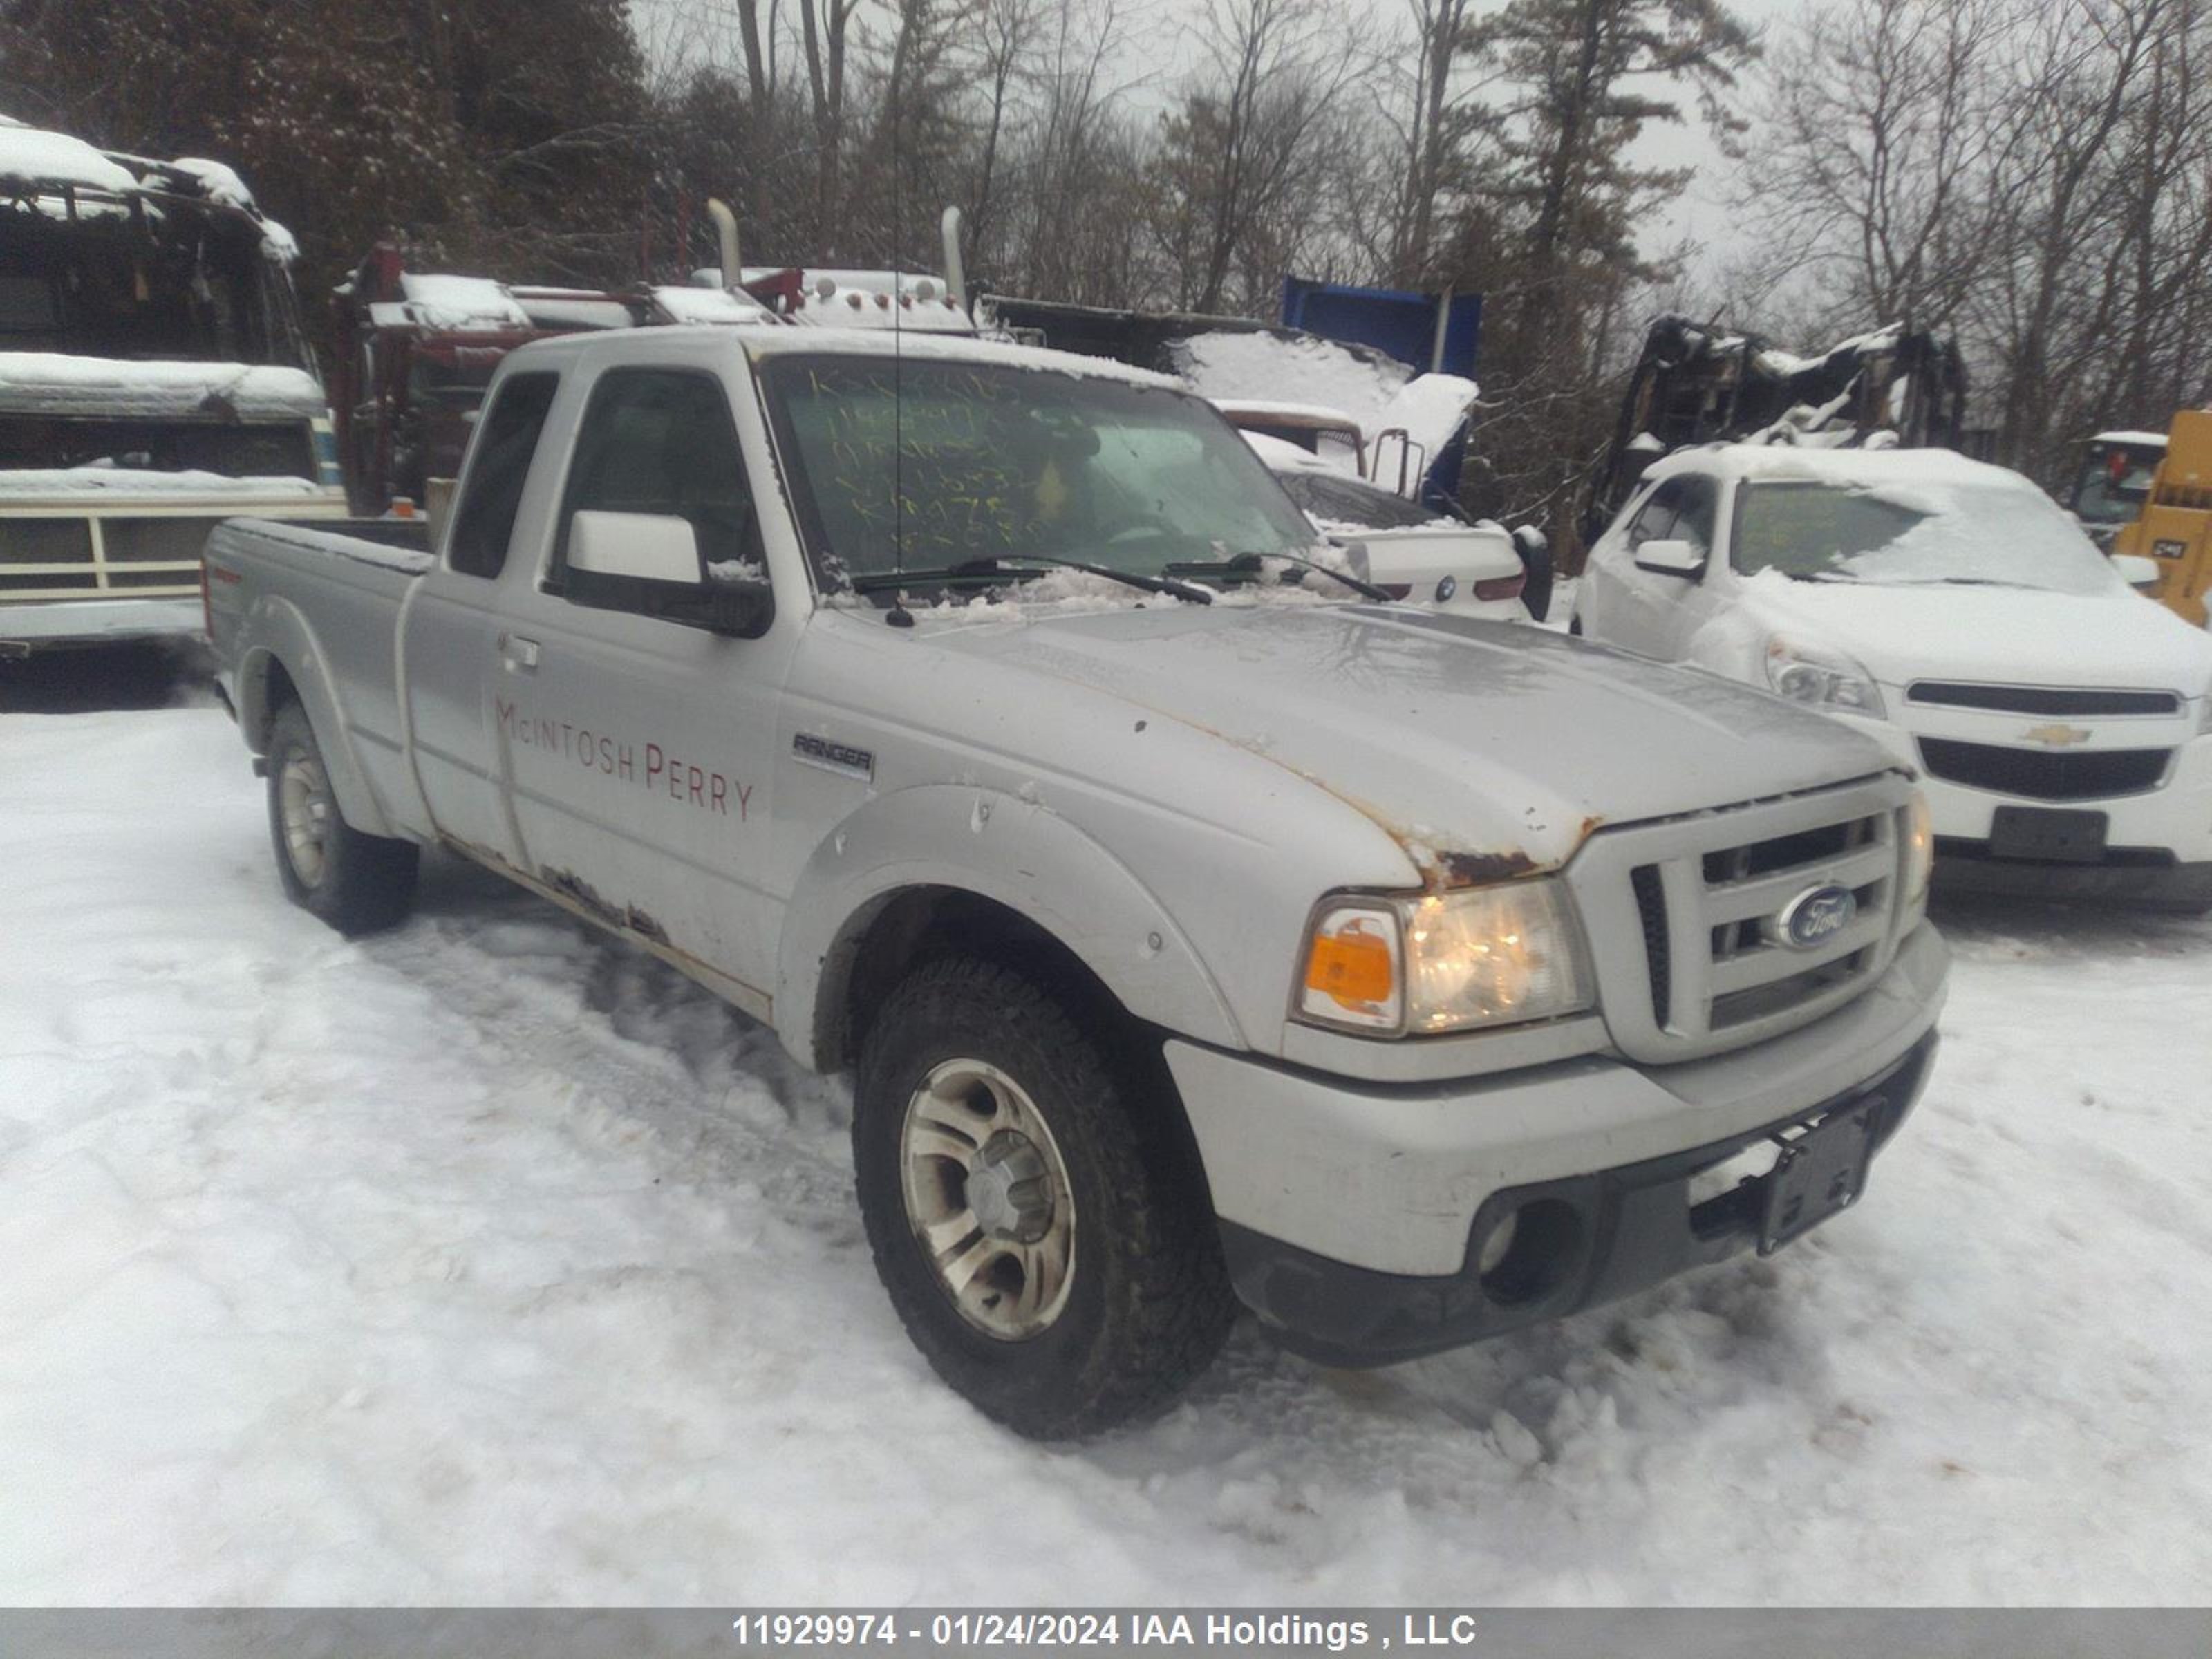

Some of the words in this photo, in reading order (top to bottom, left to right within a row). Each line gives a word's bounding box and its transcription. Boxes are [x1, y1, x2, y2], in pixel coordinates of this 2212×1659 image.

[793, 733, 872, 771] RANGER
[646, 743, 753, 822] PERRY
[1803, 898, 1849, 937] Ford
